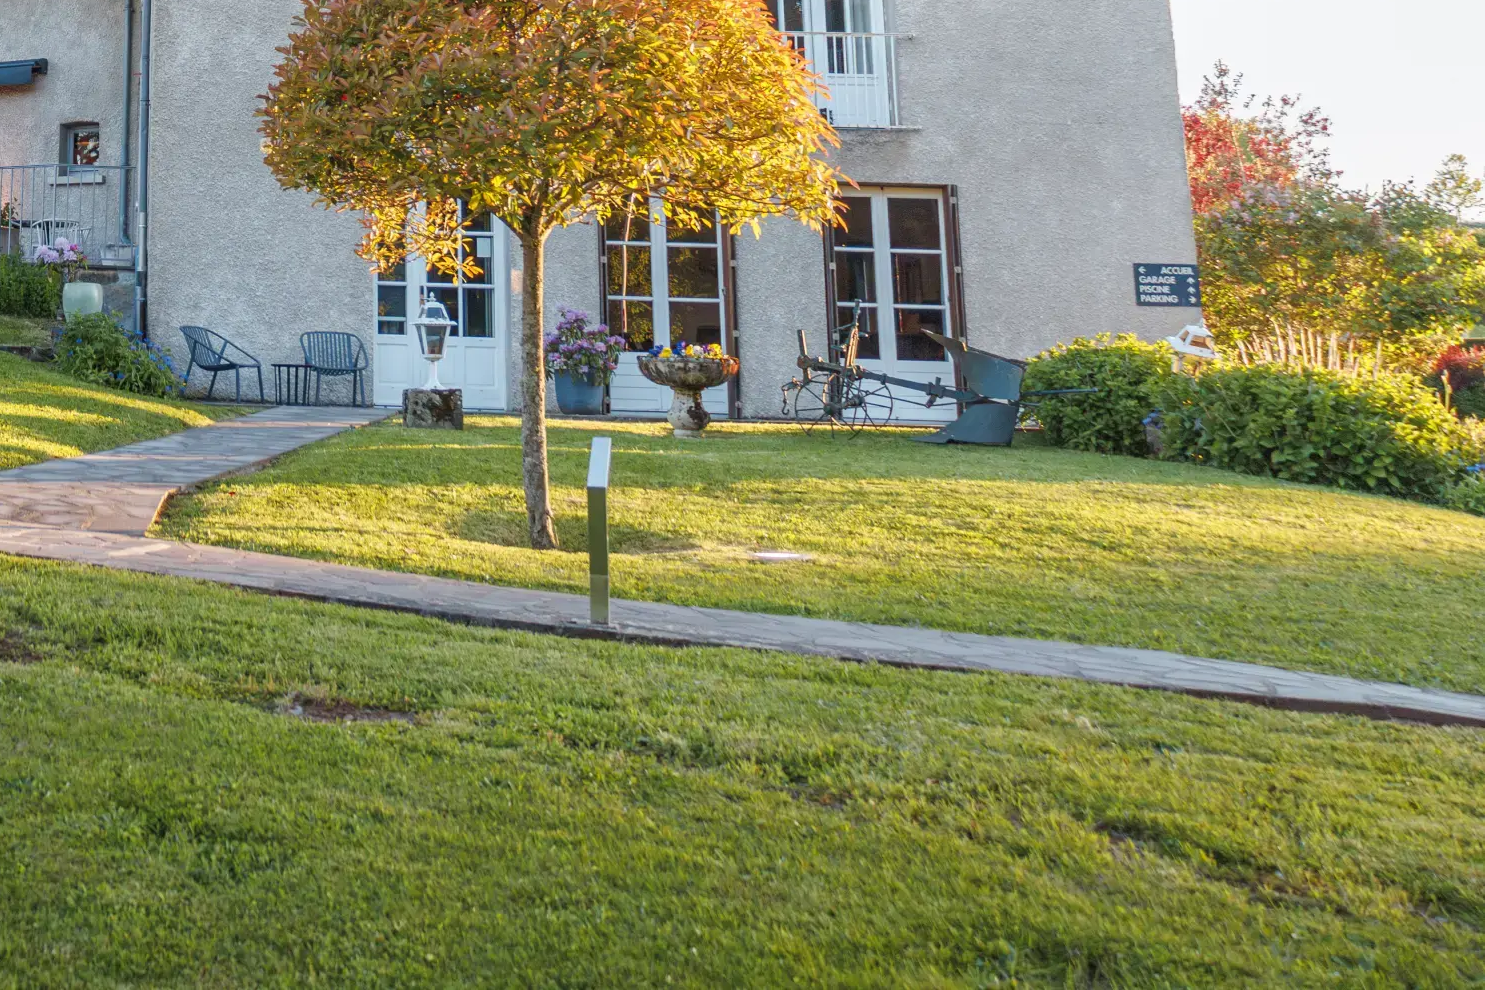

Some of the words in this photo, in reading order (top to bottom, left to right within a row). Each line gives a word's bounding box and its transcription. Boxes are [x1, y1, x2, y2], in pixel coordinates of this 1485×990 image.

[1160, 266, 1194, 275] ACCUEIL
[1138, 275, 1176, 284] GARAGE
[1139, 285, 1171, 294] PISCINE
[1140, 294, 1179, 303] PARKING
